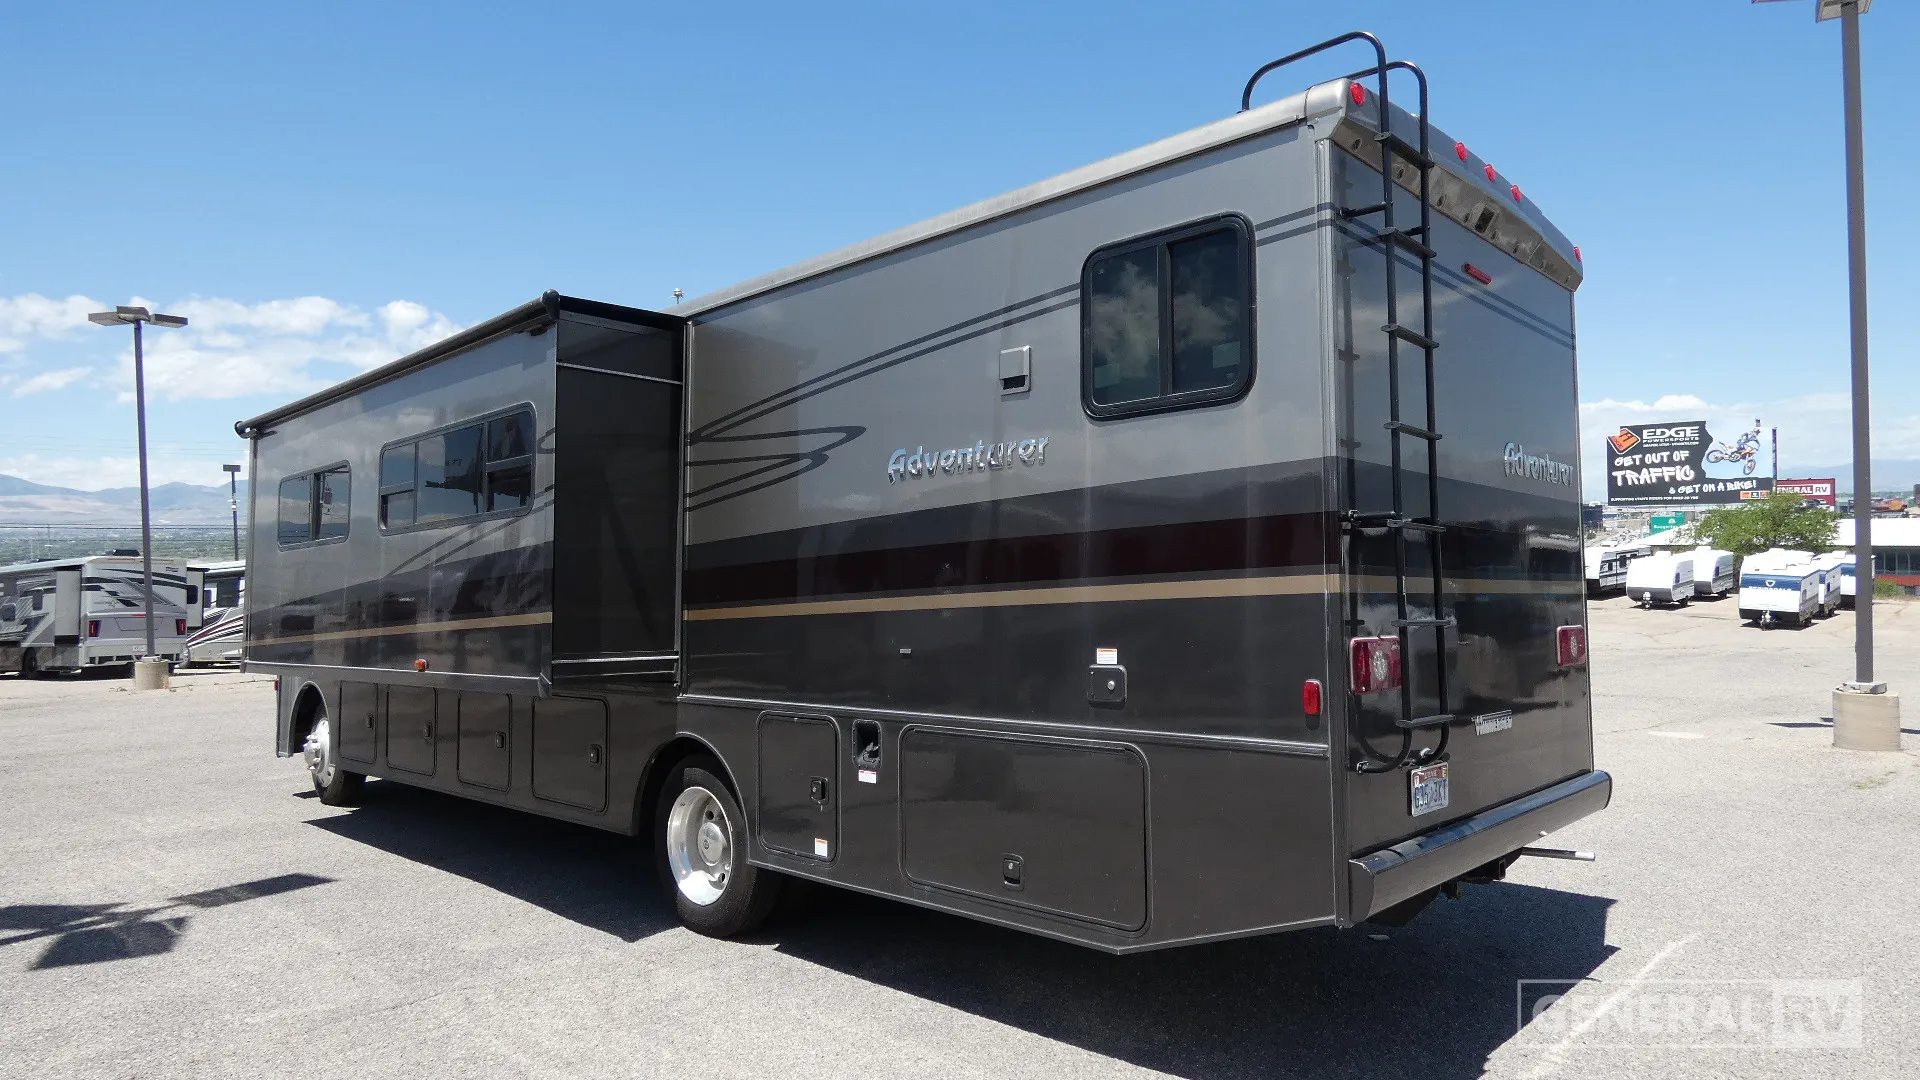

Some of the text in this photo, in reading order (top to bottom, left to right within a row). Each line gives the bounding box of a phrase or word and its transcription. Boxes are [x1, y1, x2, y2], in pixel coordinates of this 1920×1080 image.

[1642, 426, 1700, 440] EDGE
[887, 436, 1050, 485] Adventurer
[1503, 440, 1574, 487] Adventurer
[1614, 450, 1690, 466] GET OUT OF
[1612, 465, 1695, 486] TRAFFIC
[1668, 480, 1757, 495] & GET ON A BIKE!
